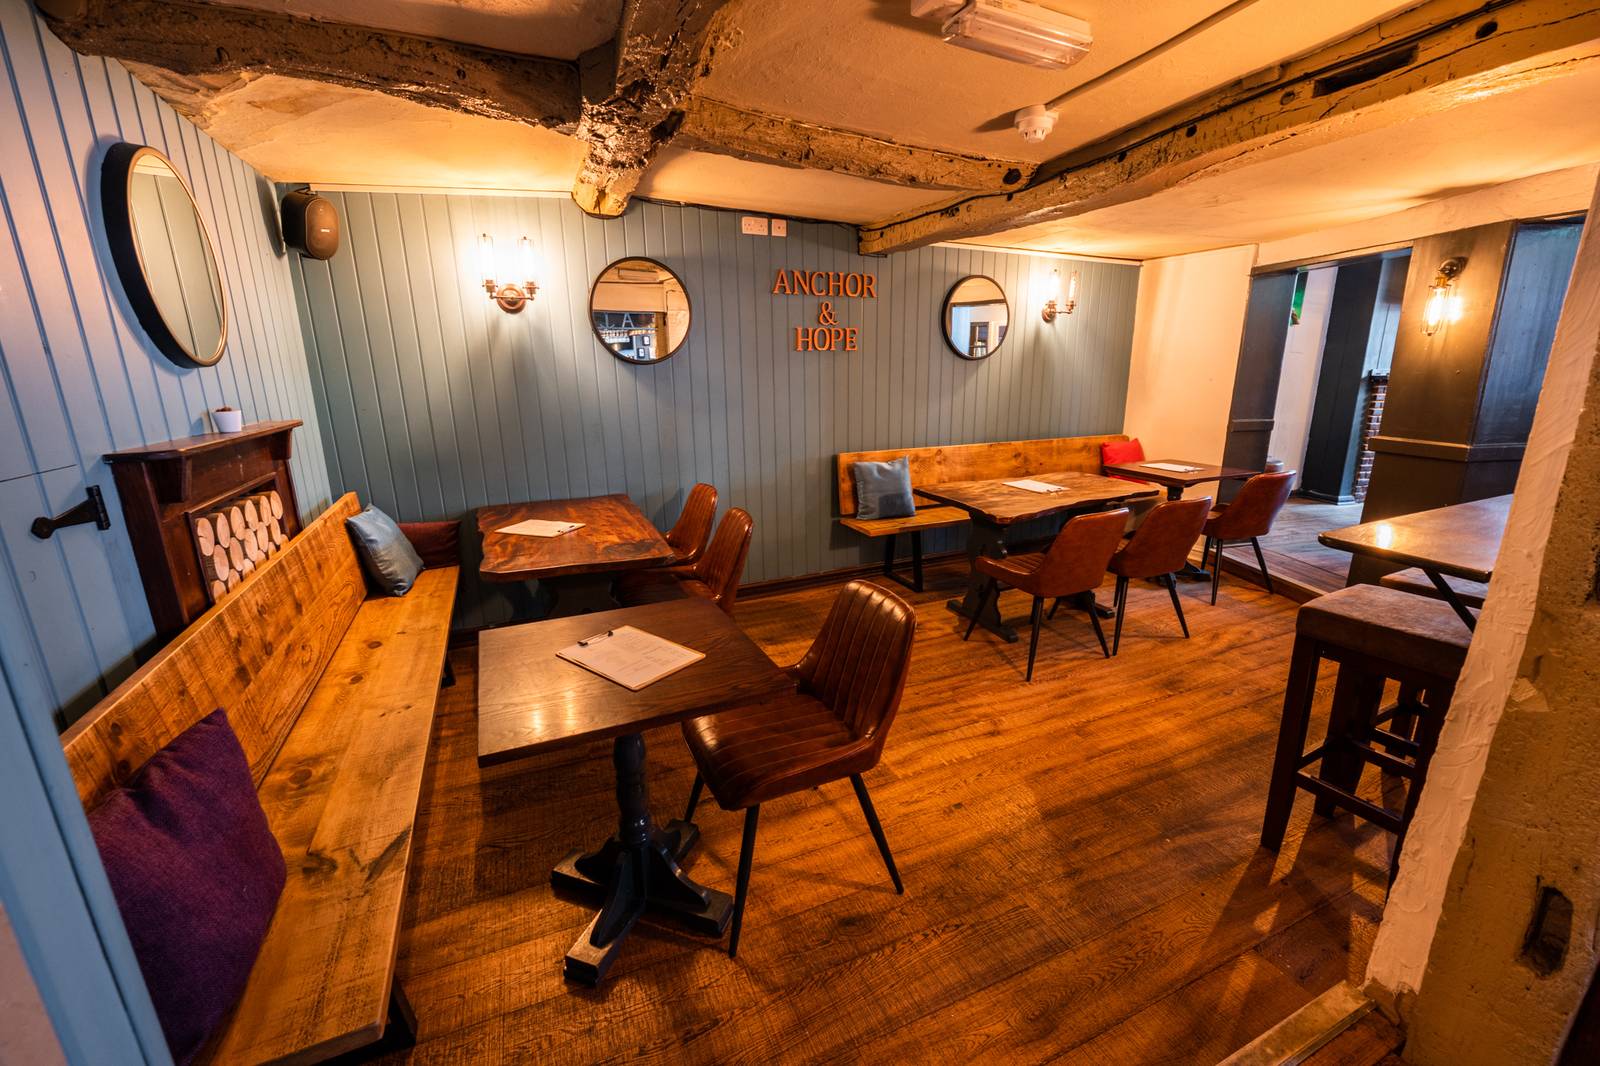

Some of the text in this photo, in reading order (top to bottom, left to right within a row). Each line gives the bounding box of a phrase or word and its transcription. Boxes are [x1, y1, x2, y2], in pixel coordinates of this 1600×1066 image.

[772, 268, 878, 298] ANCHOR
[819, 301, 839, 325] &
[796, 326, 859, 352] HOPE
